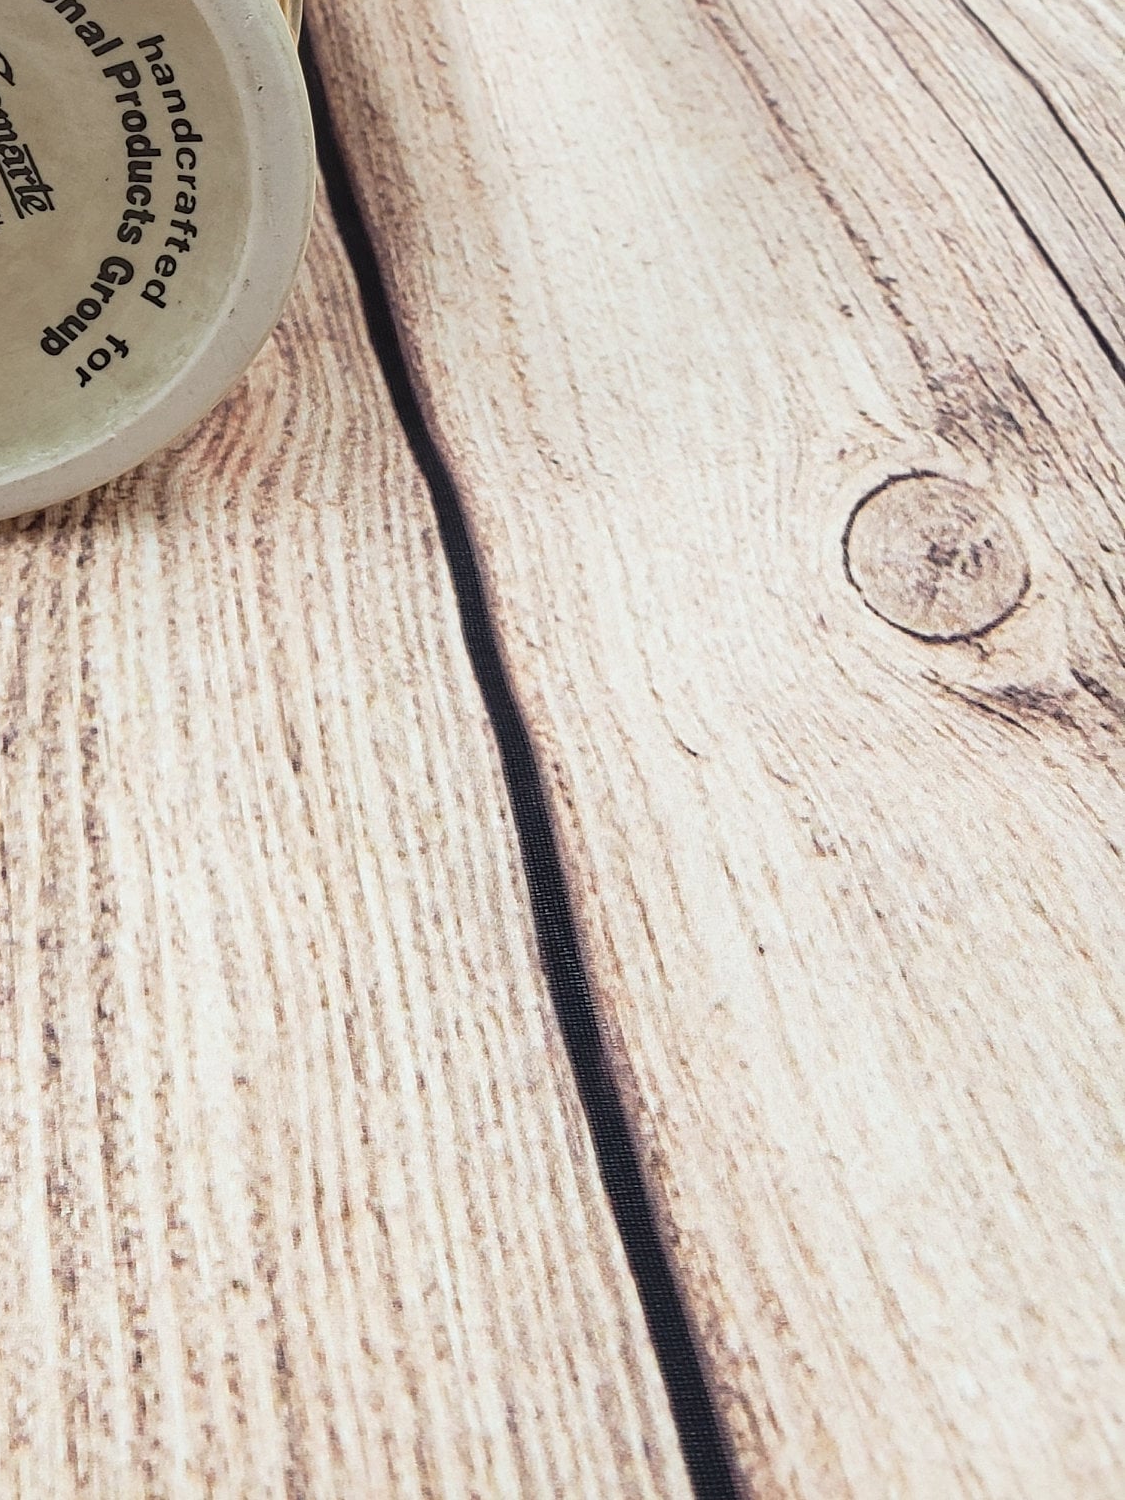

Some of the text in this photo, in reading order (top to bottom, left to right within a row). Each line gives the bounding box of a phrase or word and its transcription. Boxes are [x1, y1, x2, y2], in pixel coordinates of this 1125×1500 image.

[101, 59, 163, 246] Products
[136, 33, 204, 310] handcrafted
[39, 255, 135, 357] Group
[74, 333, 130, 389] for
